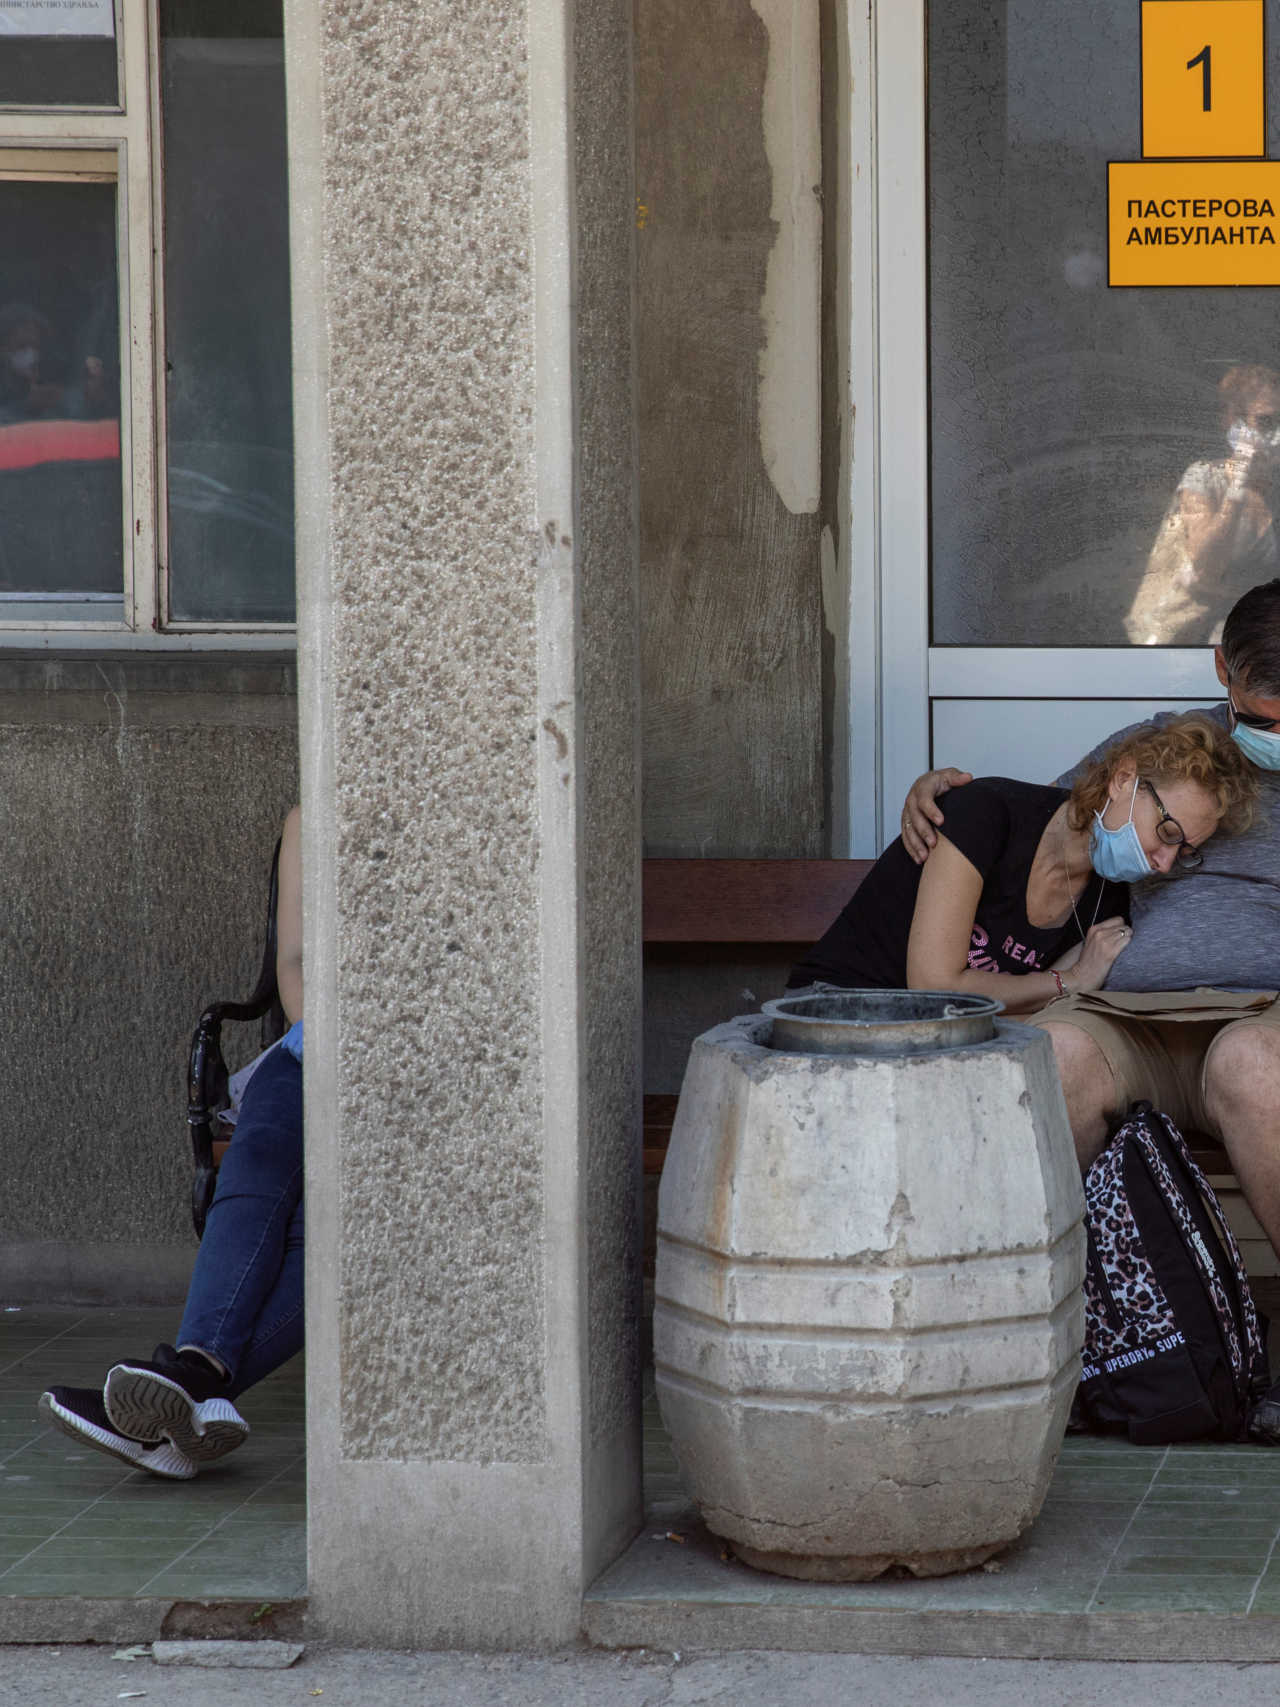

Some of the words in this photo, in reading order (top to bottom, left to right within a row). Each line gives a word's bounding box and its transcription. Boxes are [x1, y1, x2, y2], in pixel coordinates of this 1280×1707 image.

[1187, 45, 1211, 112] 1
[1127, 199, 1275, 218] ПАСТЕРОВА
[1126, 226, 1276, 246] АМБУЛАНТА
